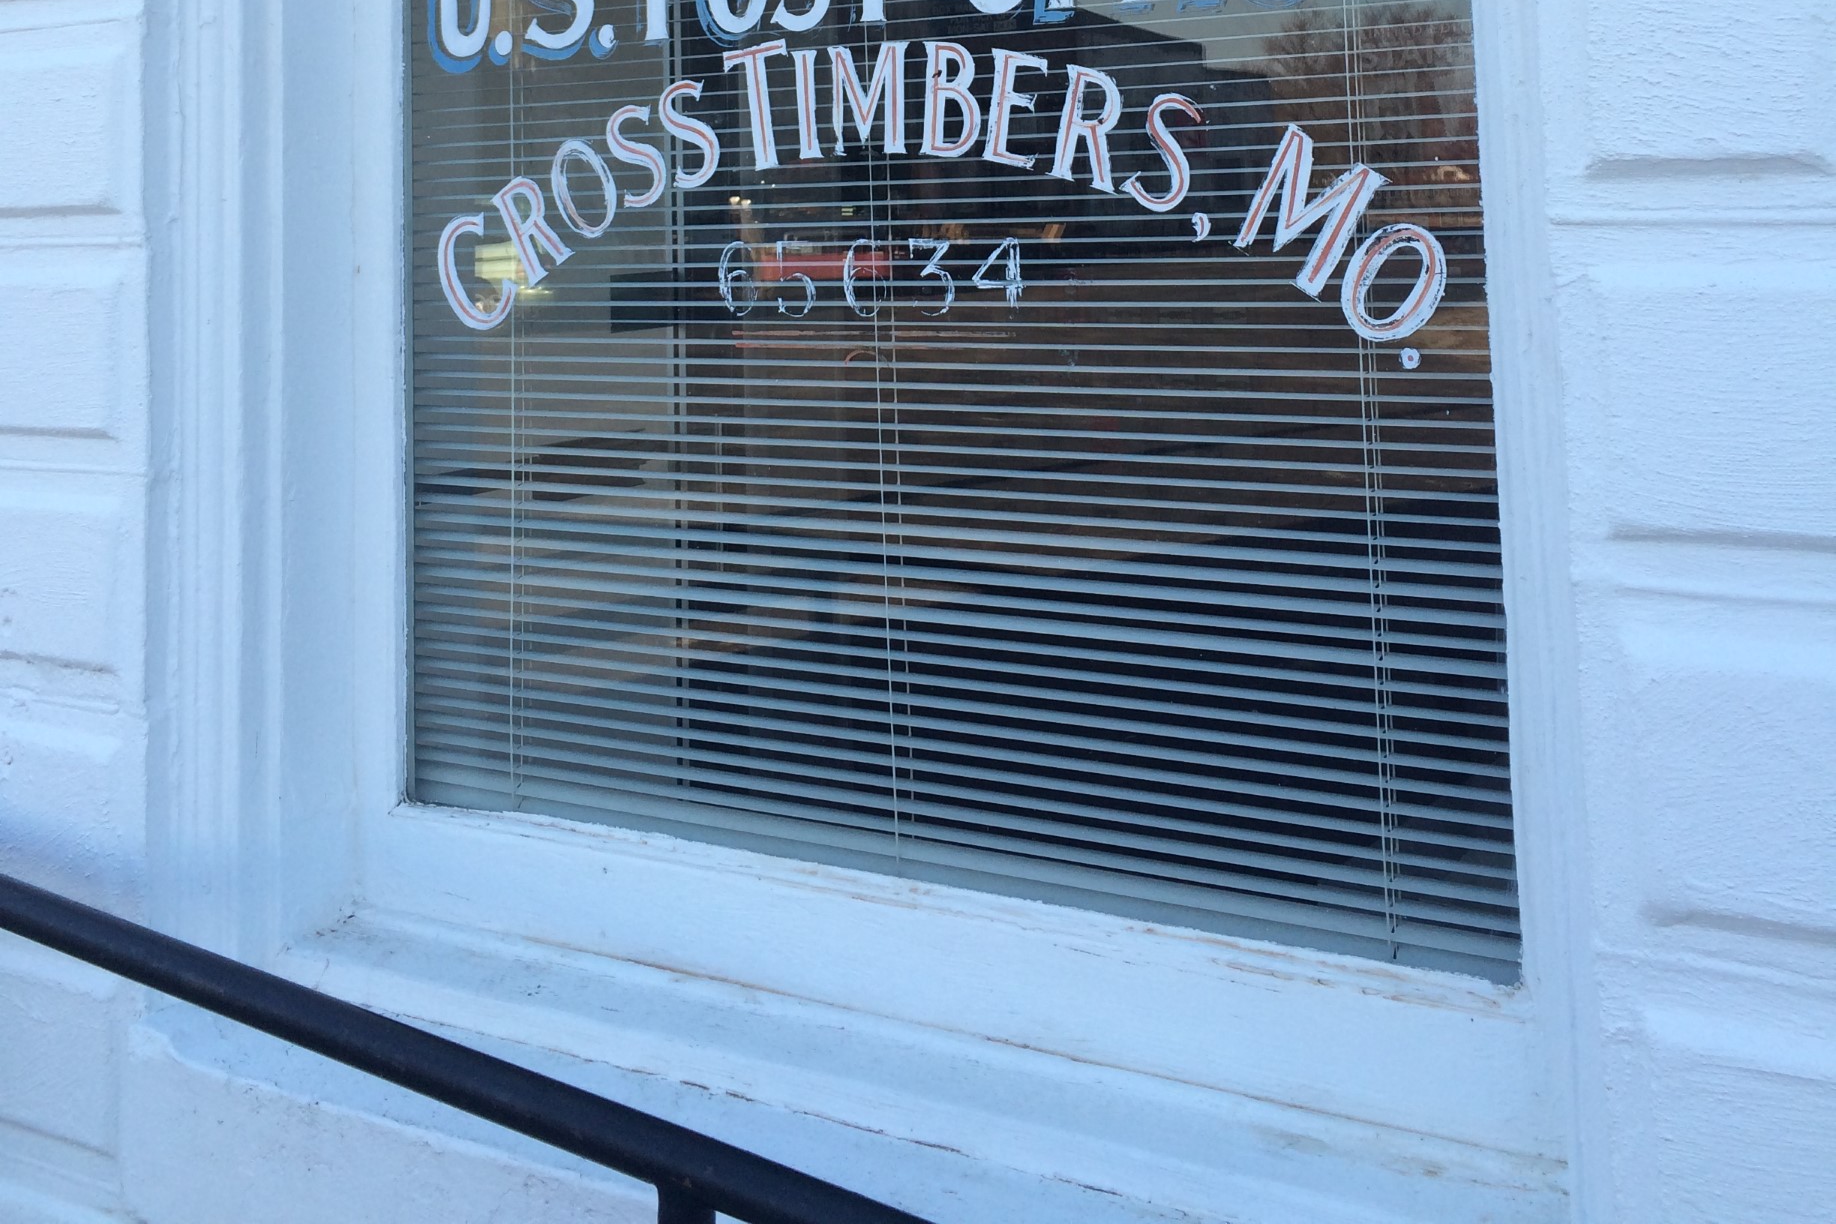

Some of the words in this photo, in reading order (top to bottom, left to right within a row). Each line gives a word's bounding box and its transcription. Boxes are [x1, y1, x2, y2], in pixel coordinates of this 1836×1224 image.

[437, 79, 720, 331] CROSS
[723, 38, 1211, 242] TIMBERS,
[1228, 123, 1447, 369] MO.
[718, 236, 1025, 318] 65634
